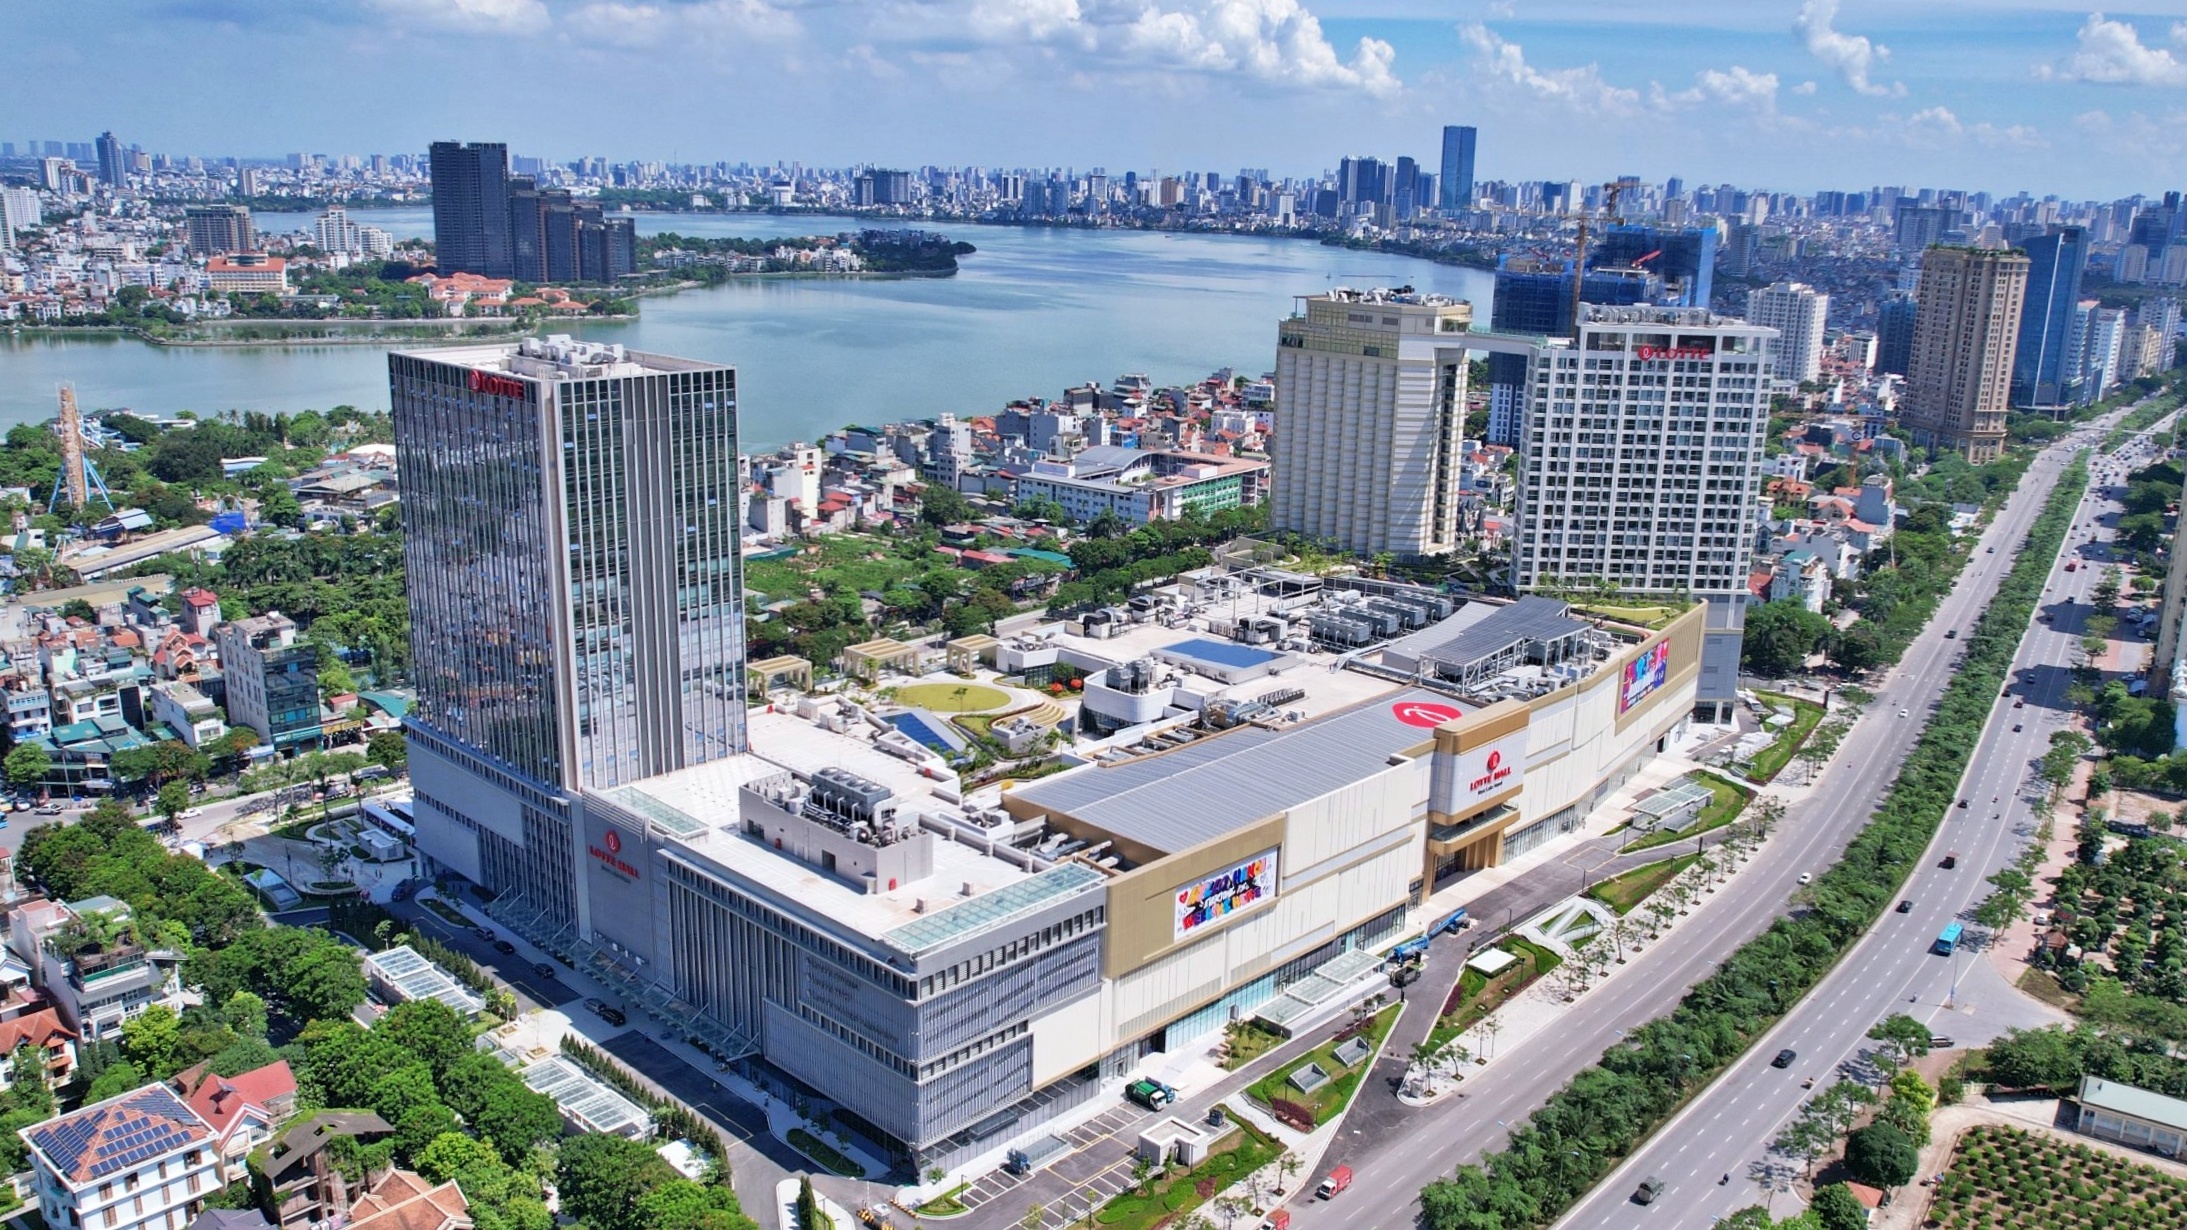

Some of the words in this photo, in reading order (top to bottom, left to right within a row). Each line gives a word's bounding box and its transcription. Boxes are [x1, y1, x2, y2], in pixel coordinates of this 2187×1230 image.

[1656, 346, 1710, 359] LOTTE
[482, 375, 524, 400] LOTTE
[1470, 775, 1492, 791] LOTTE
[1494, 766, 1511, 780] MALL
[589, 845, 616, 867] LOTTE
[616, 860, 640, 880] MALL
